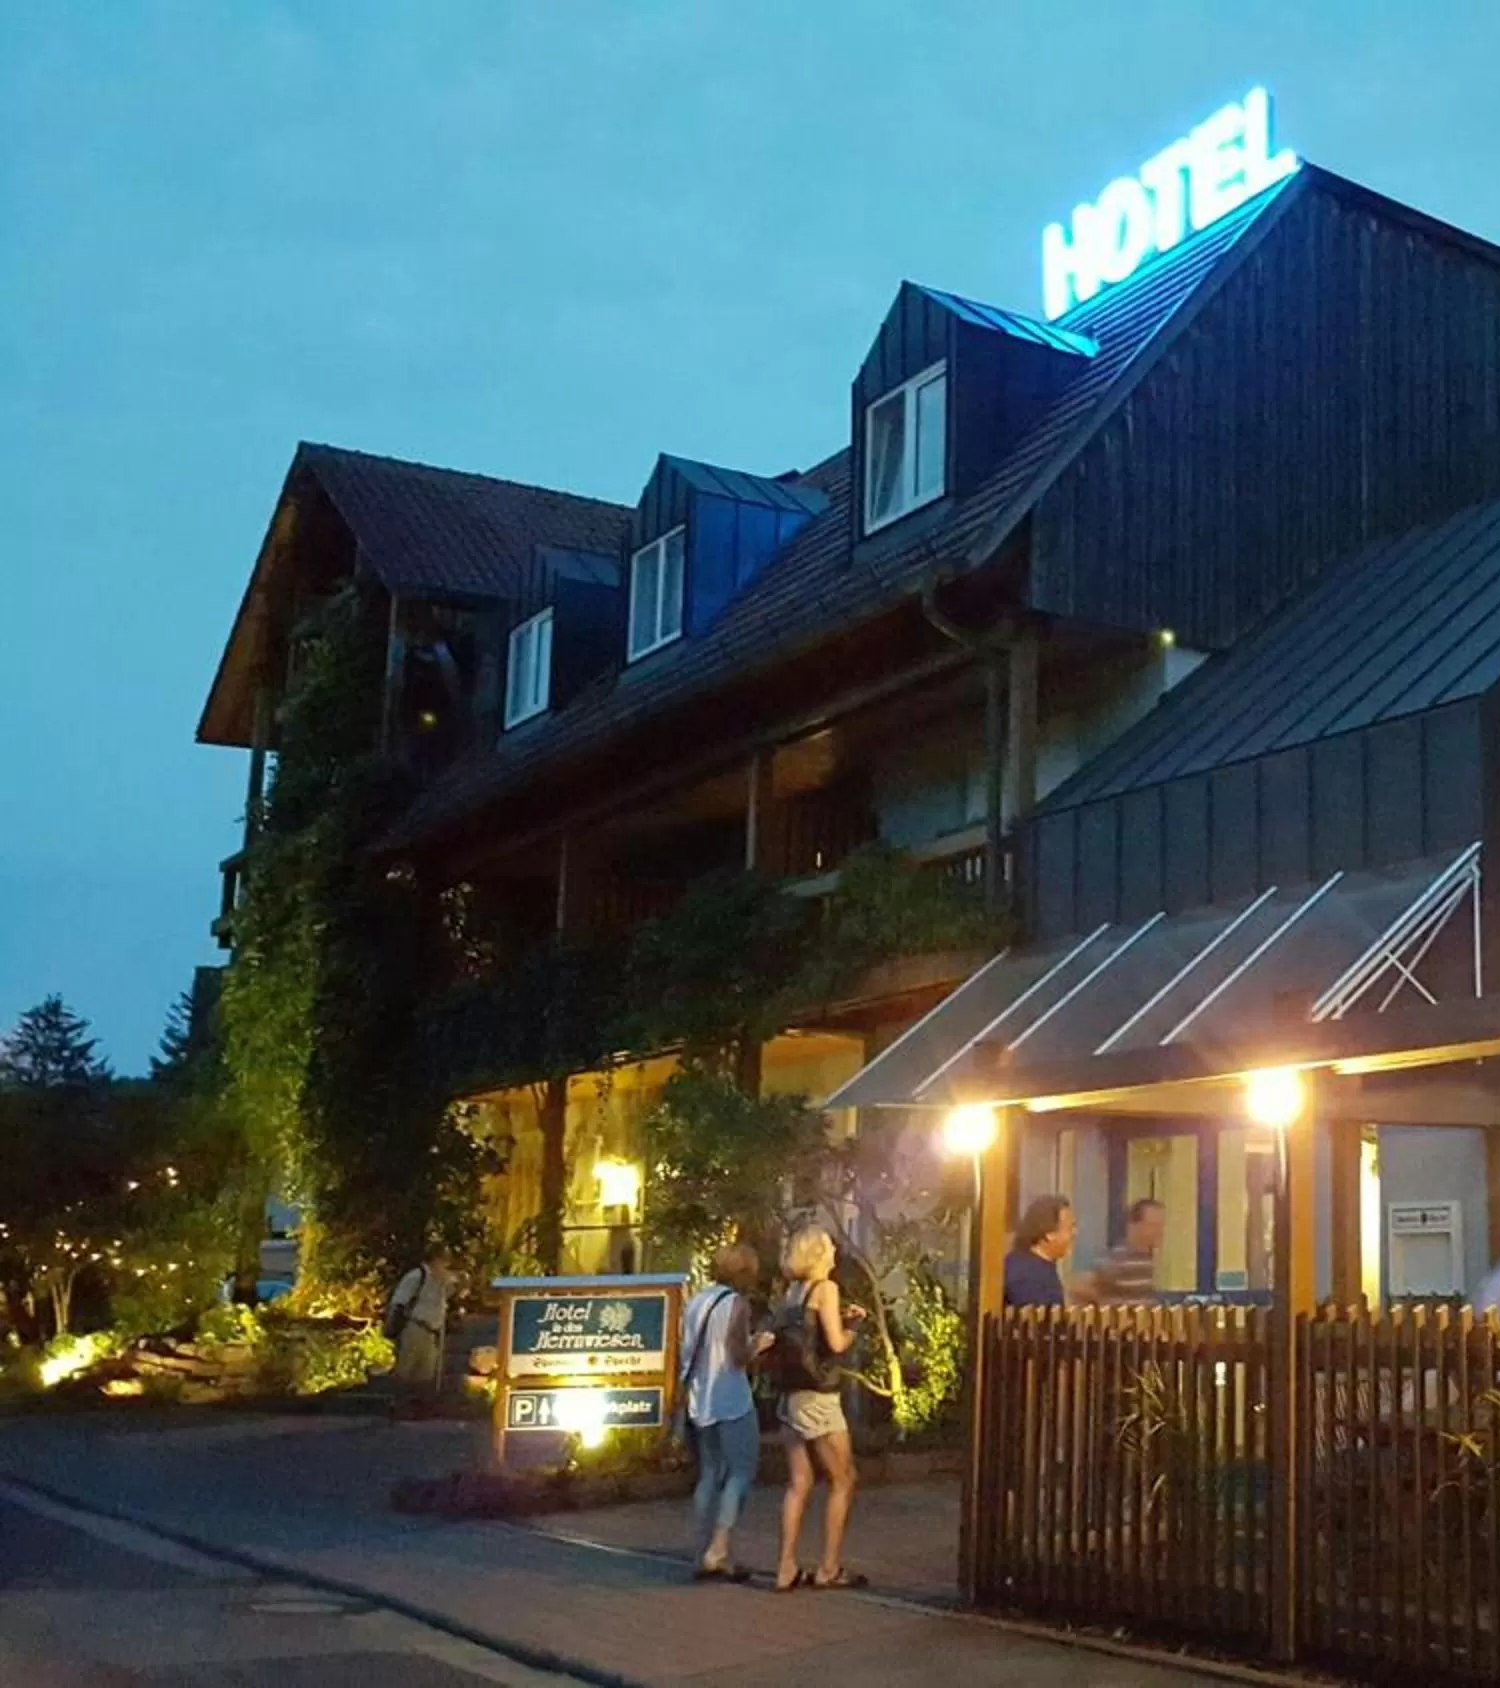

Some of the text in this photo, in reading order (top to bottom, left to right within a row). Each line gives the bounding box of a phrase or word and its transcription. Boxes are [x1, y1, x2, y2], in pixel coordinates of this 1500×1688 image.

[1042, 84, 1298, 322] HOTEL
[536, 1301, 592, 1323] Hotel
[514, 1399, 533, 1422] P
